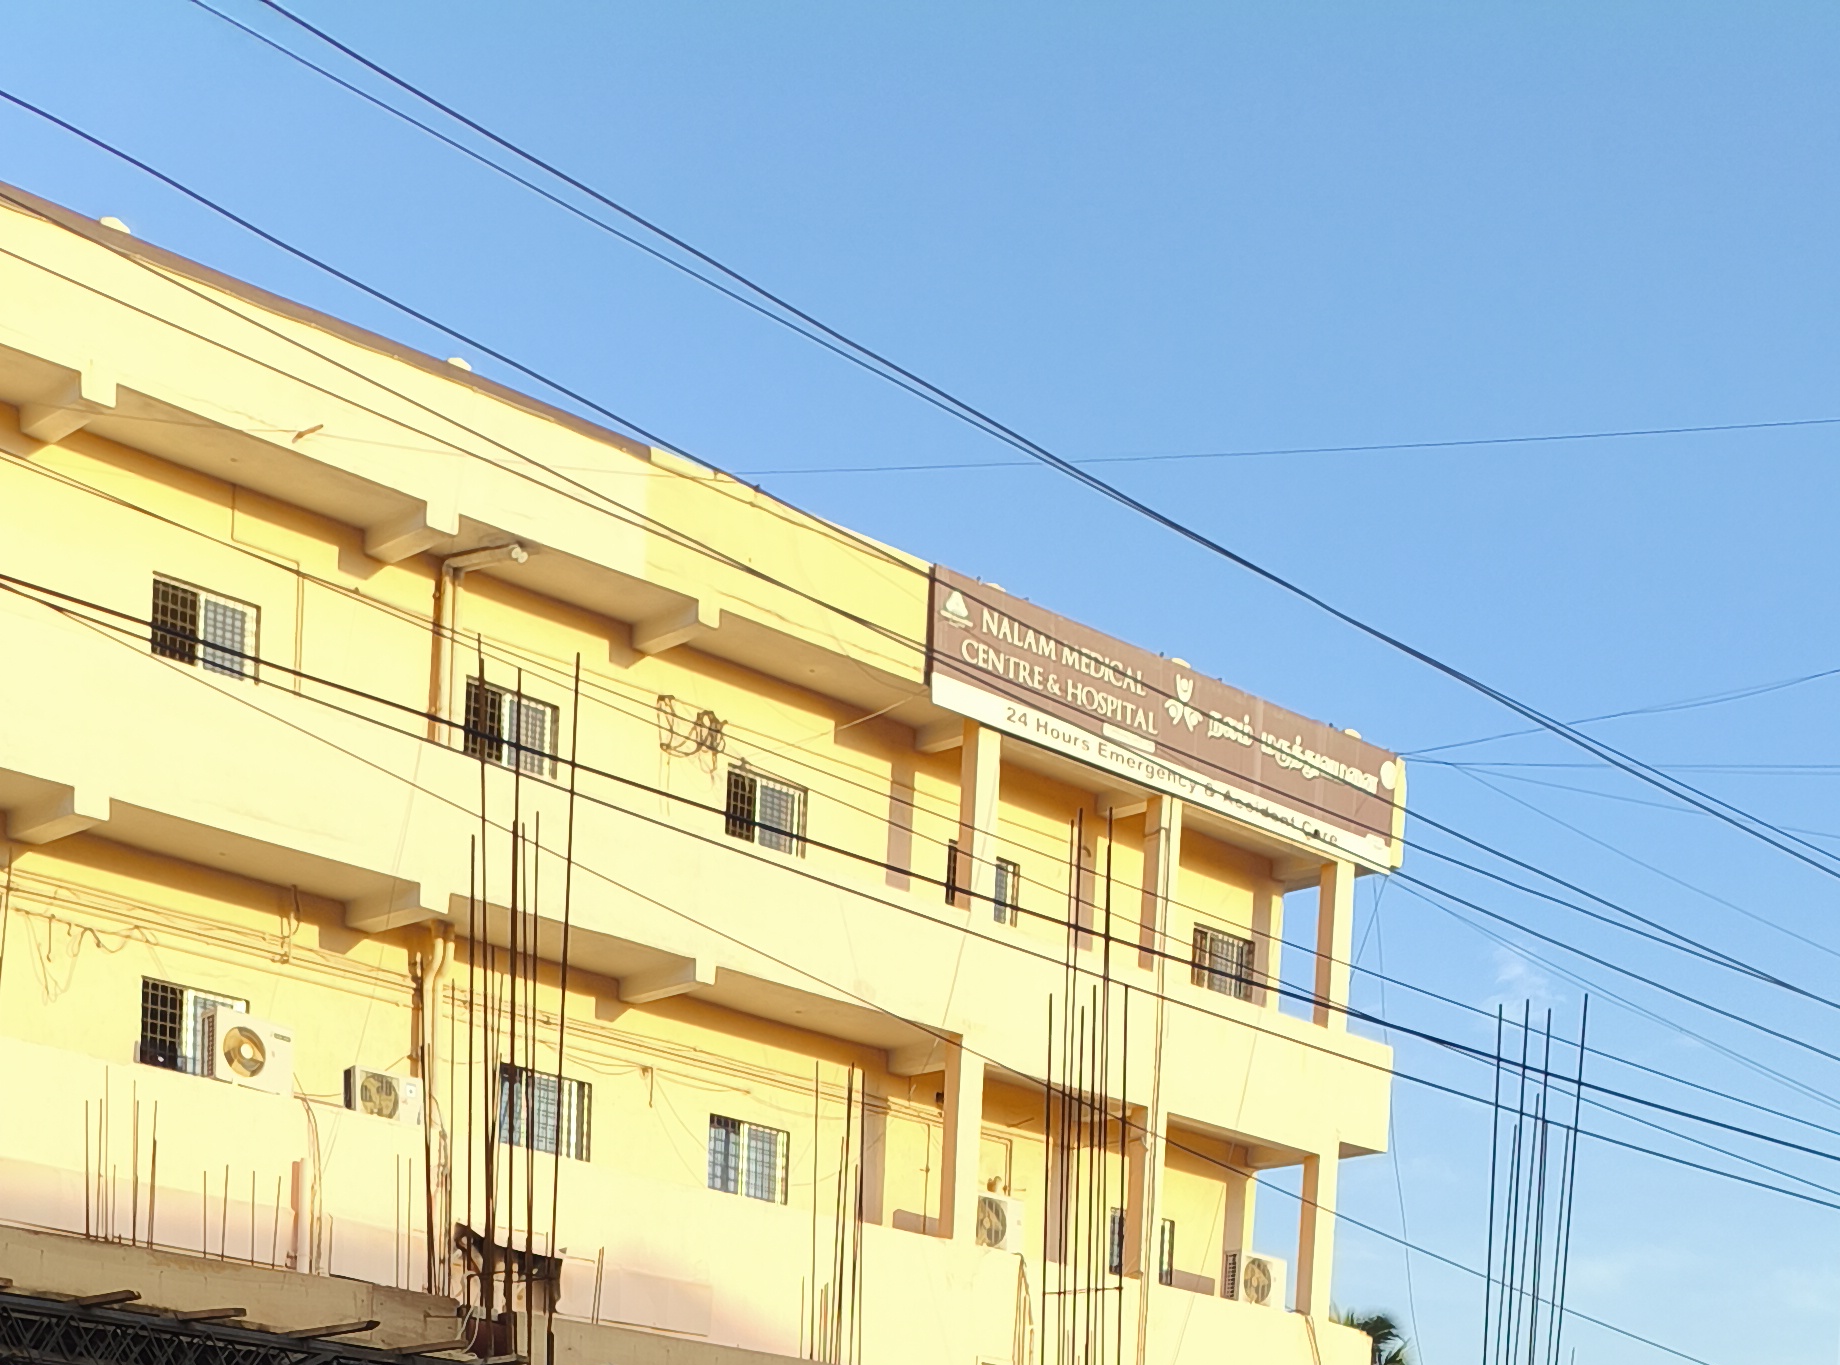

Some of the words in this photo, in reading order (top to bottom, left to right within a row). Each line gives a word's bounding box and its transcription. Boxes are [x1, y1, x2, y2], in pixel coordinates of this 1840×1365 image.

[961, 639, 1043, 690] CENTRE
[1047, 674, 1061, 696] &
[1067, 679, 1158, 735] HOSPITAL
[982, 607, 1056, 660] NALAM
[1061, 643, 1147, 696] MEDICAL
[1007, 706, 1028, 727] 24
[1036, 718, 1090, 751] Hours
[1098, 741, 1196, 794] Emergency
